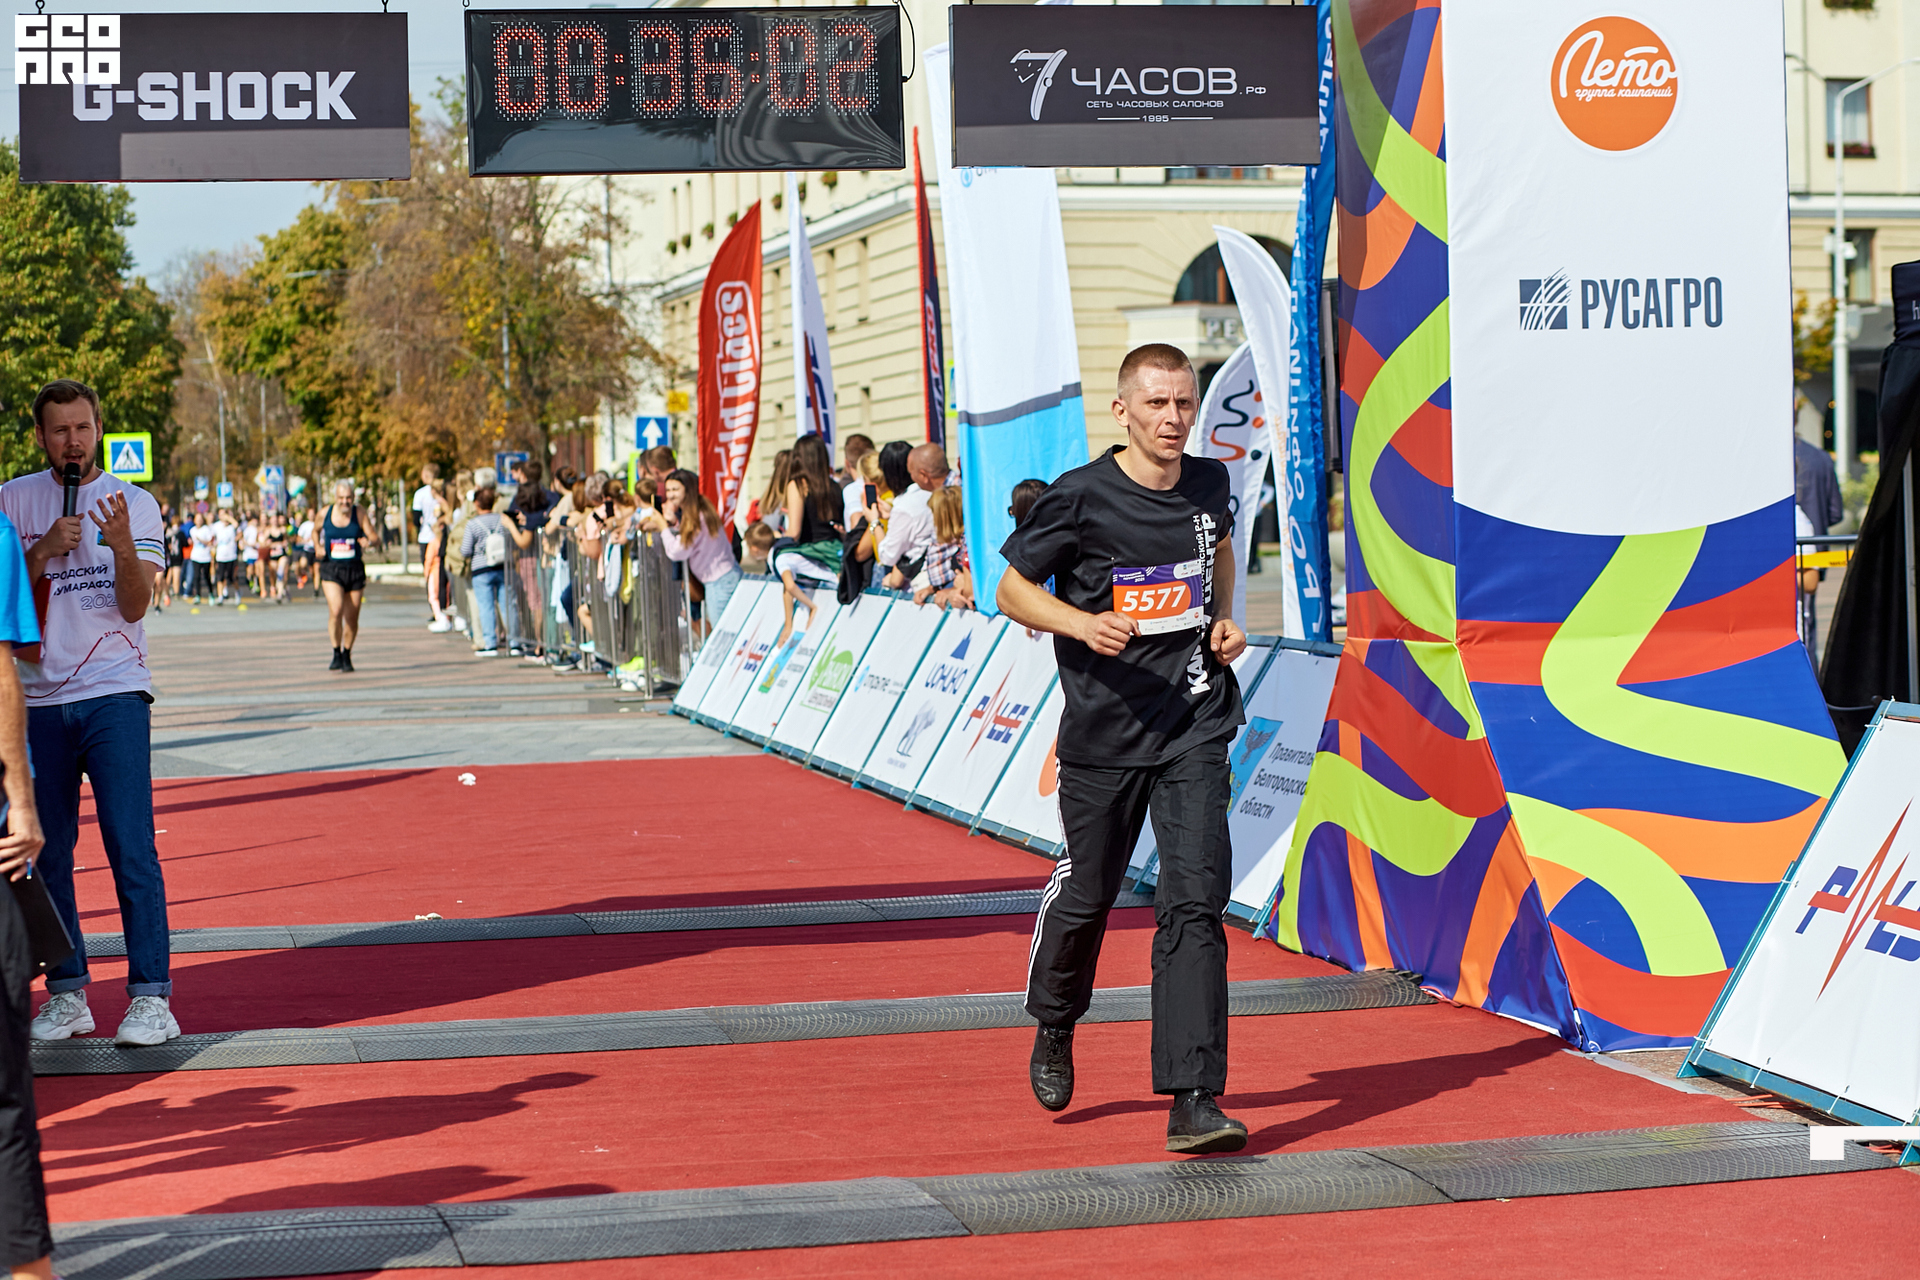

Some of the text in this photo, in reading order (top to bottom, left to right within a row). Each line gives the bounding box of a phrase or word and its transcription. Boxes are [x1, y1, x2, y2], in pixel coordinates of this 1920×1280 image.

[495, 23, 877, 115] 00:36:02
[1559, 30, 1677, 98] Лето
[73, 71, 357, 122] G-SHOCK
[1086, 100, 1224, 109] СЕТЬ ЧАСОВЫХ САЛОНОВ
[1575, 86, 1674, 102] группа компаний
[1142, 114, 1170, 123] 1995
[1580, 276, 1724, 330] РУСАГРО
[1200, 512, 1217, 604] ЦЕНТР
[1121, 584, 1187, 613] 5577
[1239, 796, 1275, 820] области
